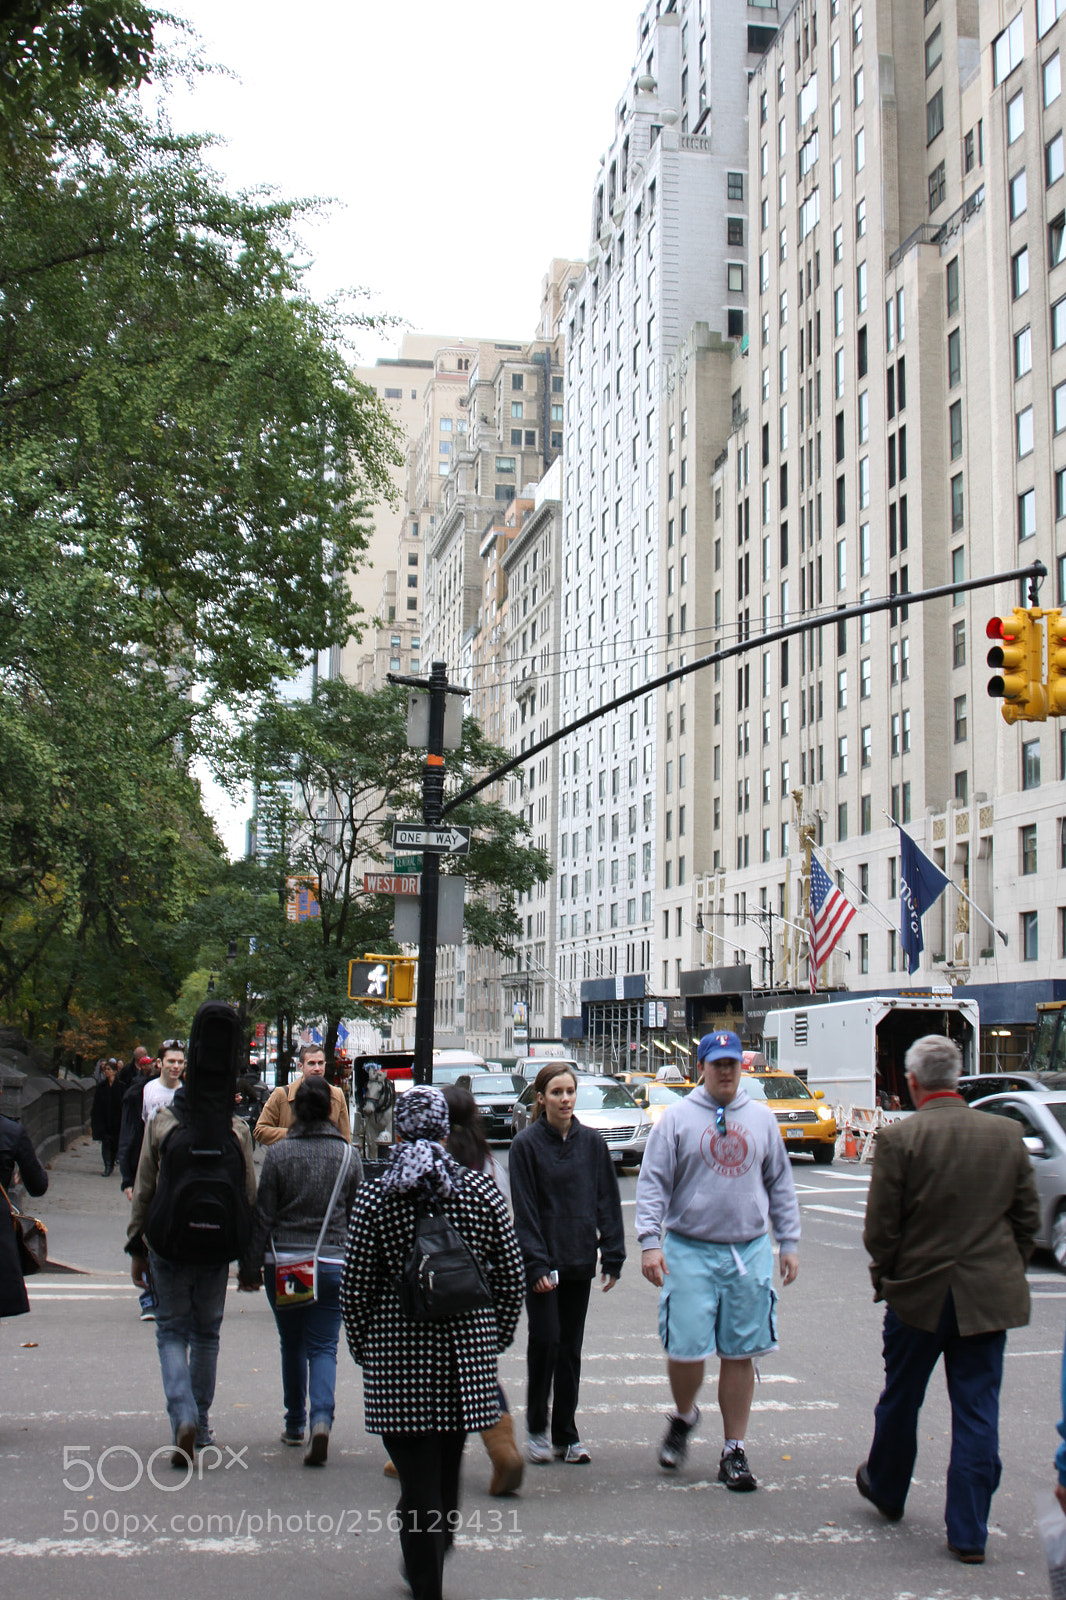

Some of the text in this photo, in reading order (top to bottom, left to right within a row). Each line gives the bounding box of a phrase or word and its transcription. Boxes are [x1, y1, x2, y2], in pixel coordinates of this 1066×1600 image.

[400, 832, 459, 845] ONE WAY
[367, 876, 417, 894] WEST DR
